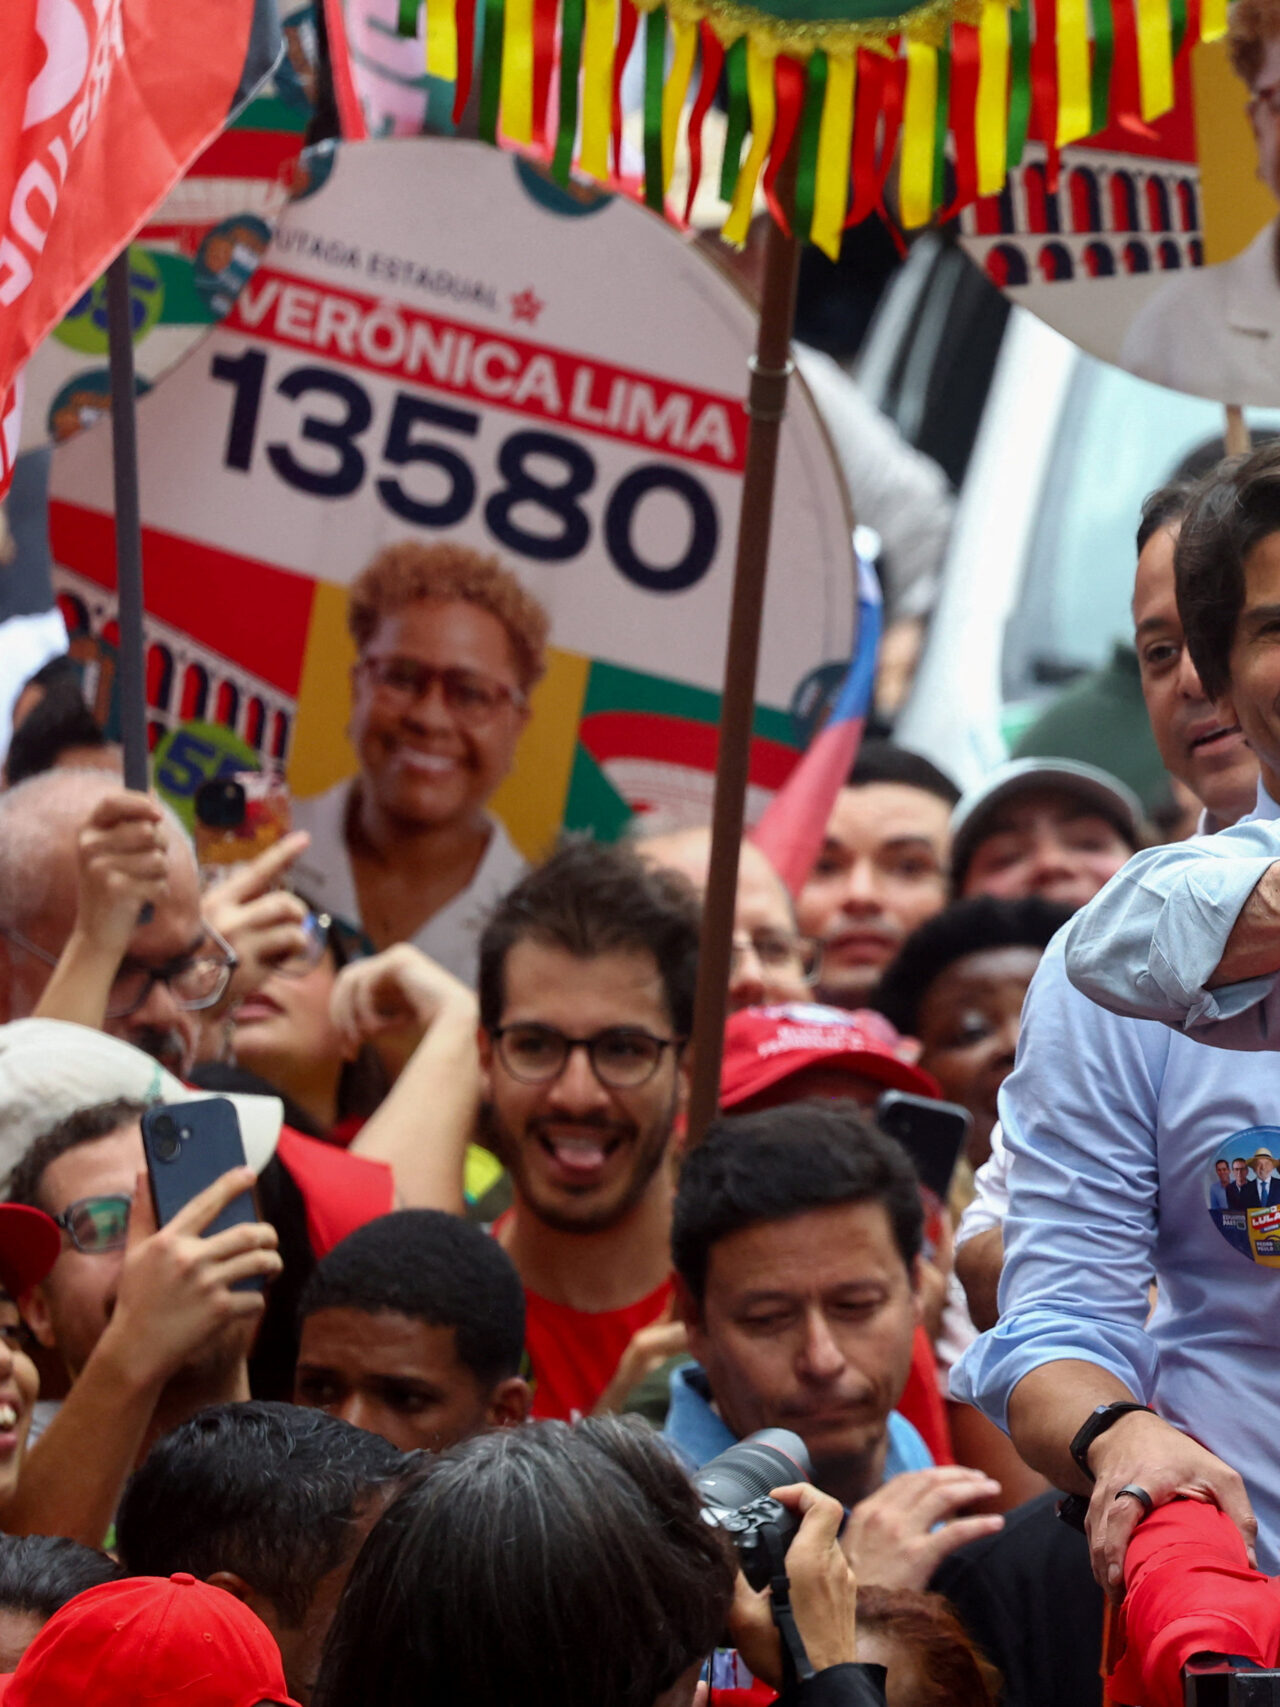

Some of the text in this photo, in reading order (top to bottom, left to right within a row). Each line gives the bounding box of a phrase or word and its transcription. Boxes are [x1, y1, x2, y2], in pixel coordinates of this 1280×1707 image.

[239, 279, 564, 414] VERÔNICA
[569, 369, 735, 460] LIMA
[364, 250, 498, 313] ESTADUAL
[210, 346, 719, 593] 13580
